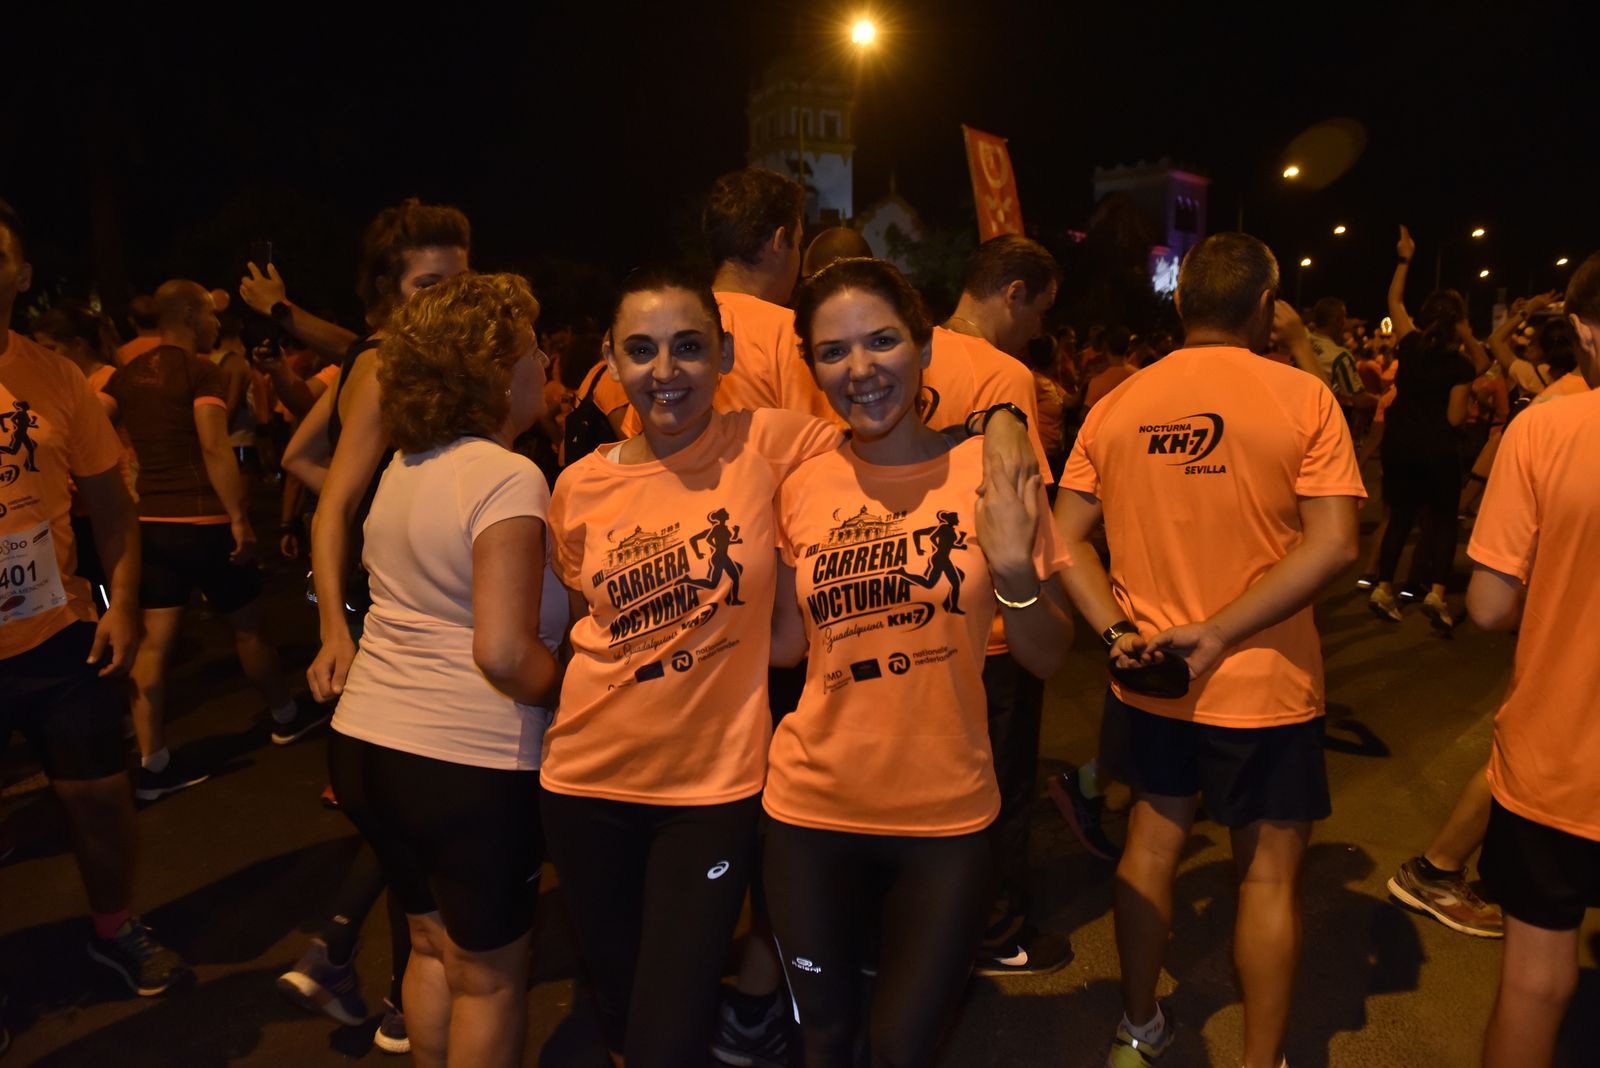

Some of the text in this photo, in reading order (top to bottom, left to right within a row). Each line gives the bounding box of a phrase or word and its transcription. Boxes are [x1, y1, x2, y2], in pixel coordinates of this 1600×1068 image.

[1139, 424, 1191, 433] NOCTURNA
[1185, 465, 1226, 475] SEVILLA
[607, 546, 690, 610] CARRERA
[813, 538, 907, 584] CARRERA
[610, 585, 700, 642] NOCTURNA
[807, 576, 911, 624] NOCTURNA
